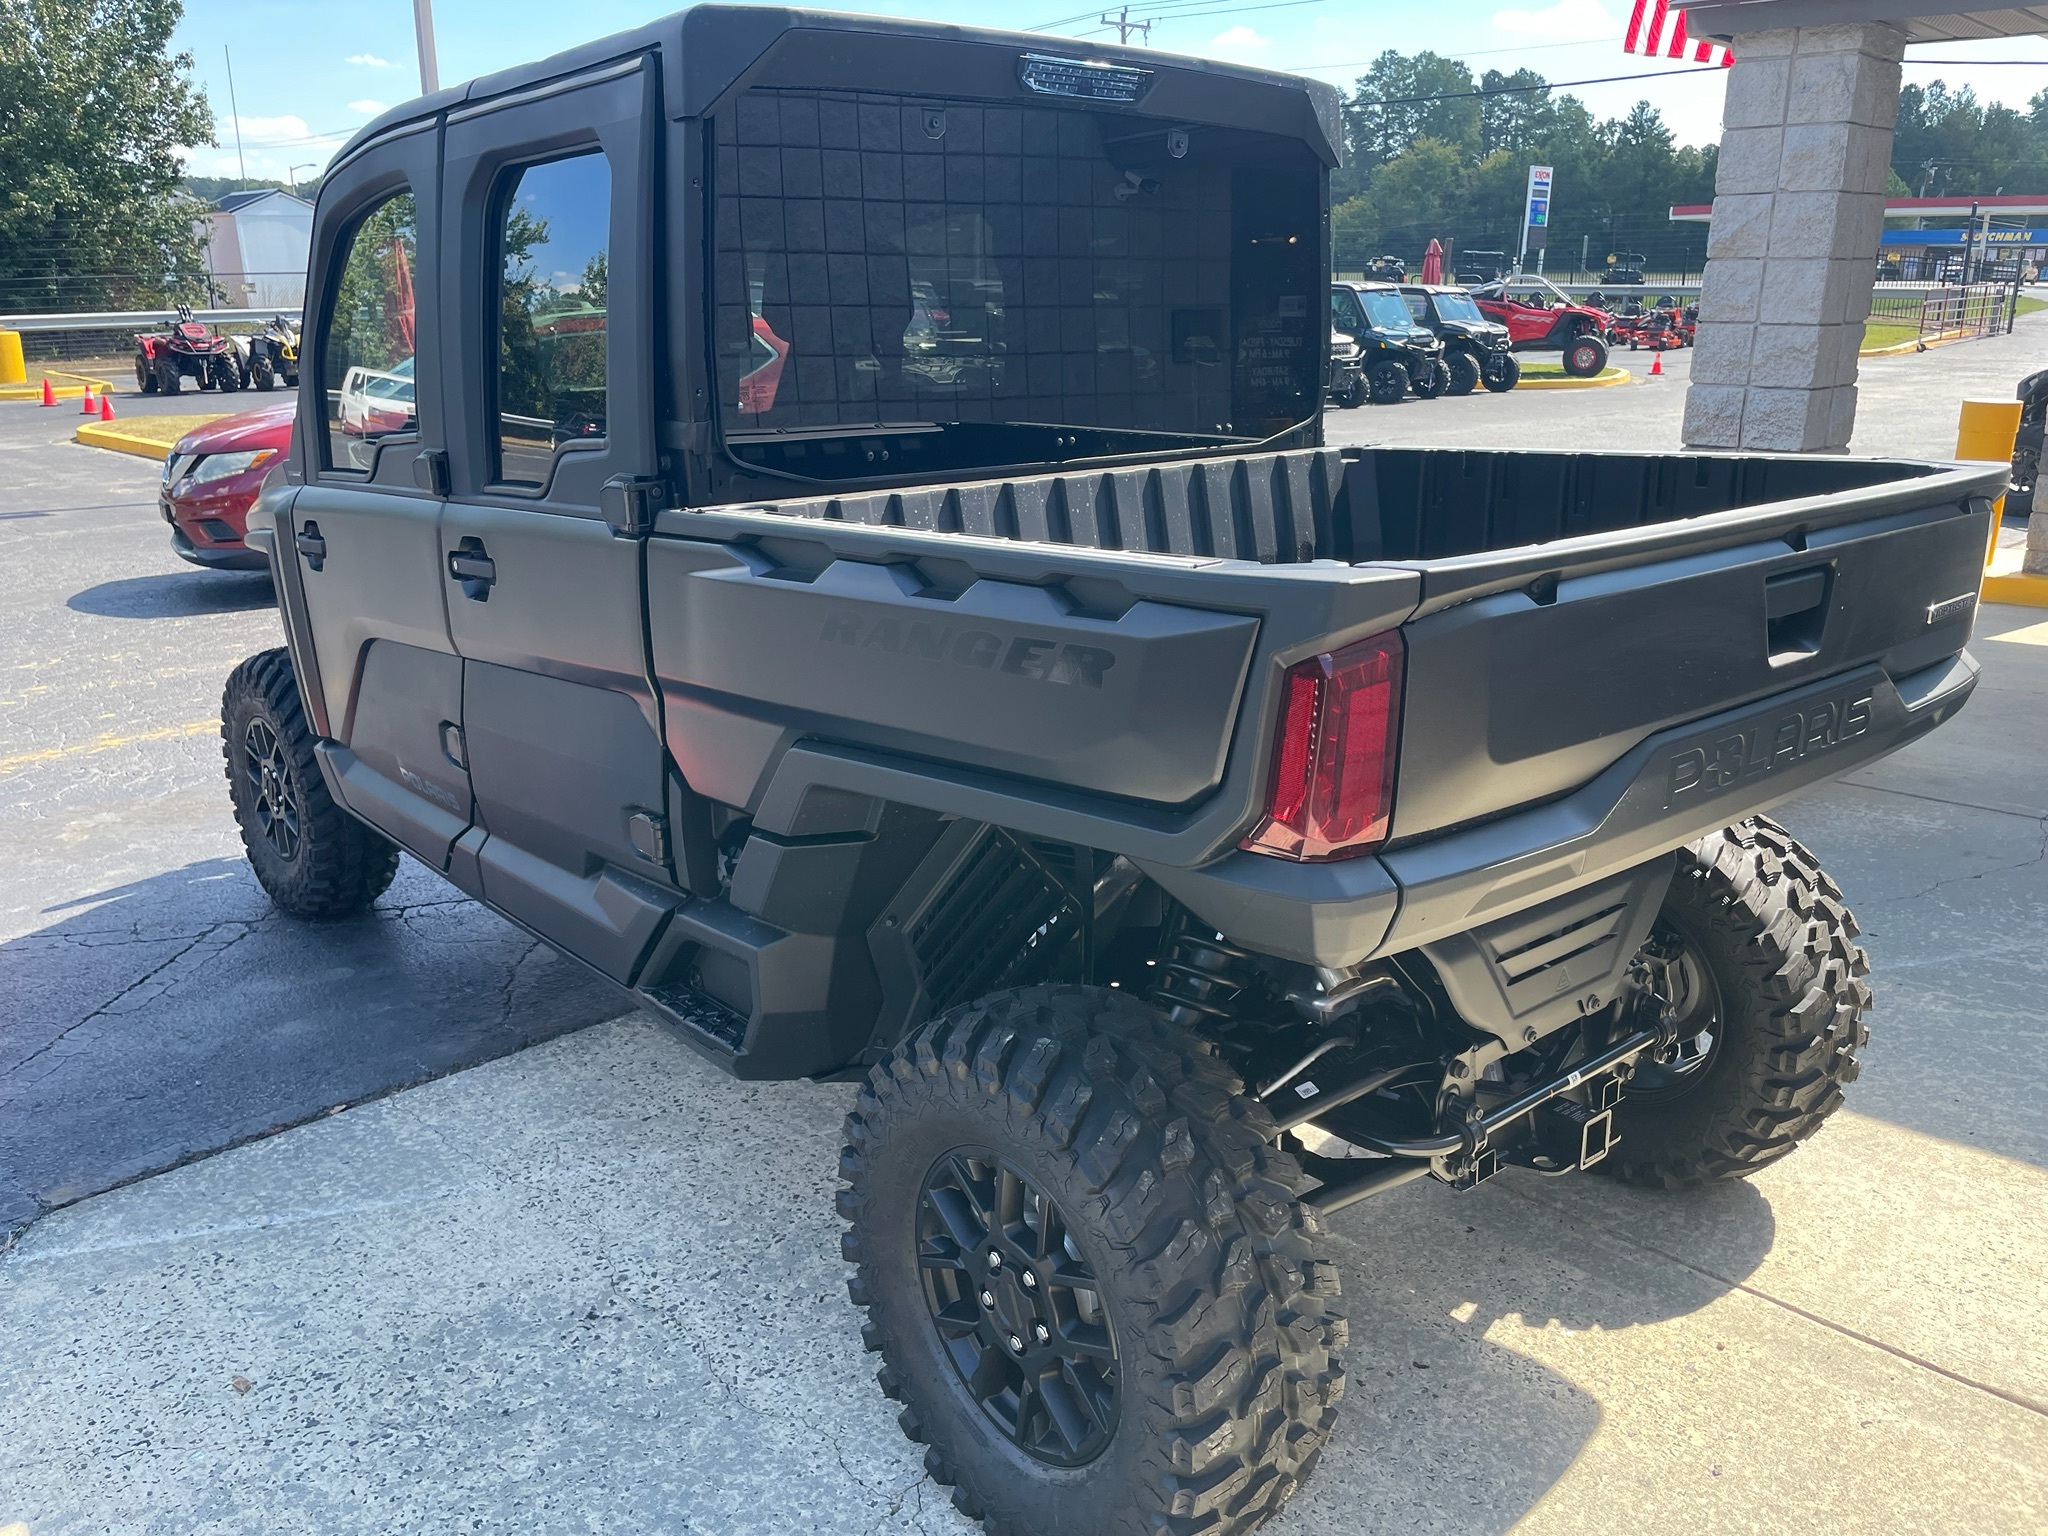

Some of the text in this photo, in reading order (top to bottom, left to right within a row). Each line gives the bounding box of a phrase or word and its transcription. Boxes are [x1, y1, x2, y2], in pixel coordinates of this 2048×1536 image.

[1535, 170, 1550, 182] EXXON
[1960, 231, 2032, 242] SOCHMAN
[1512, 313, 1554, 324] RZR
[818, 608, 1116, 690] RANGER
[1664, 687, 1873, 810] POLARIS
[399, 766, 461, 811] POLARIS
